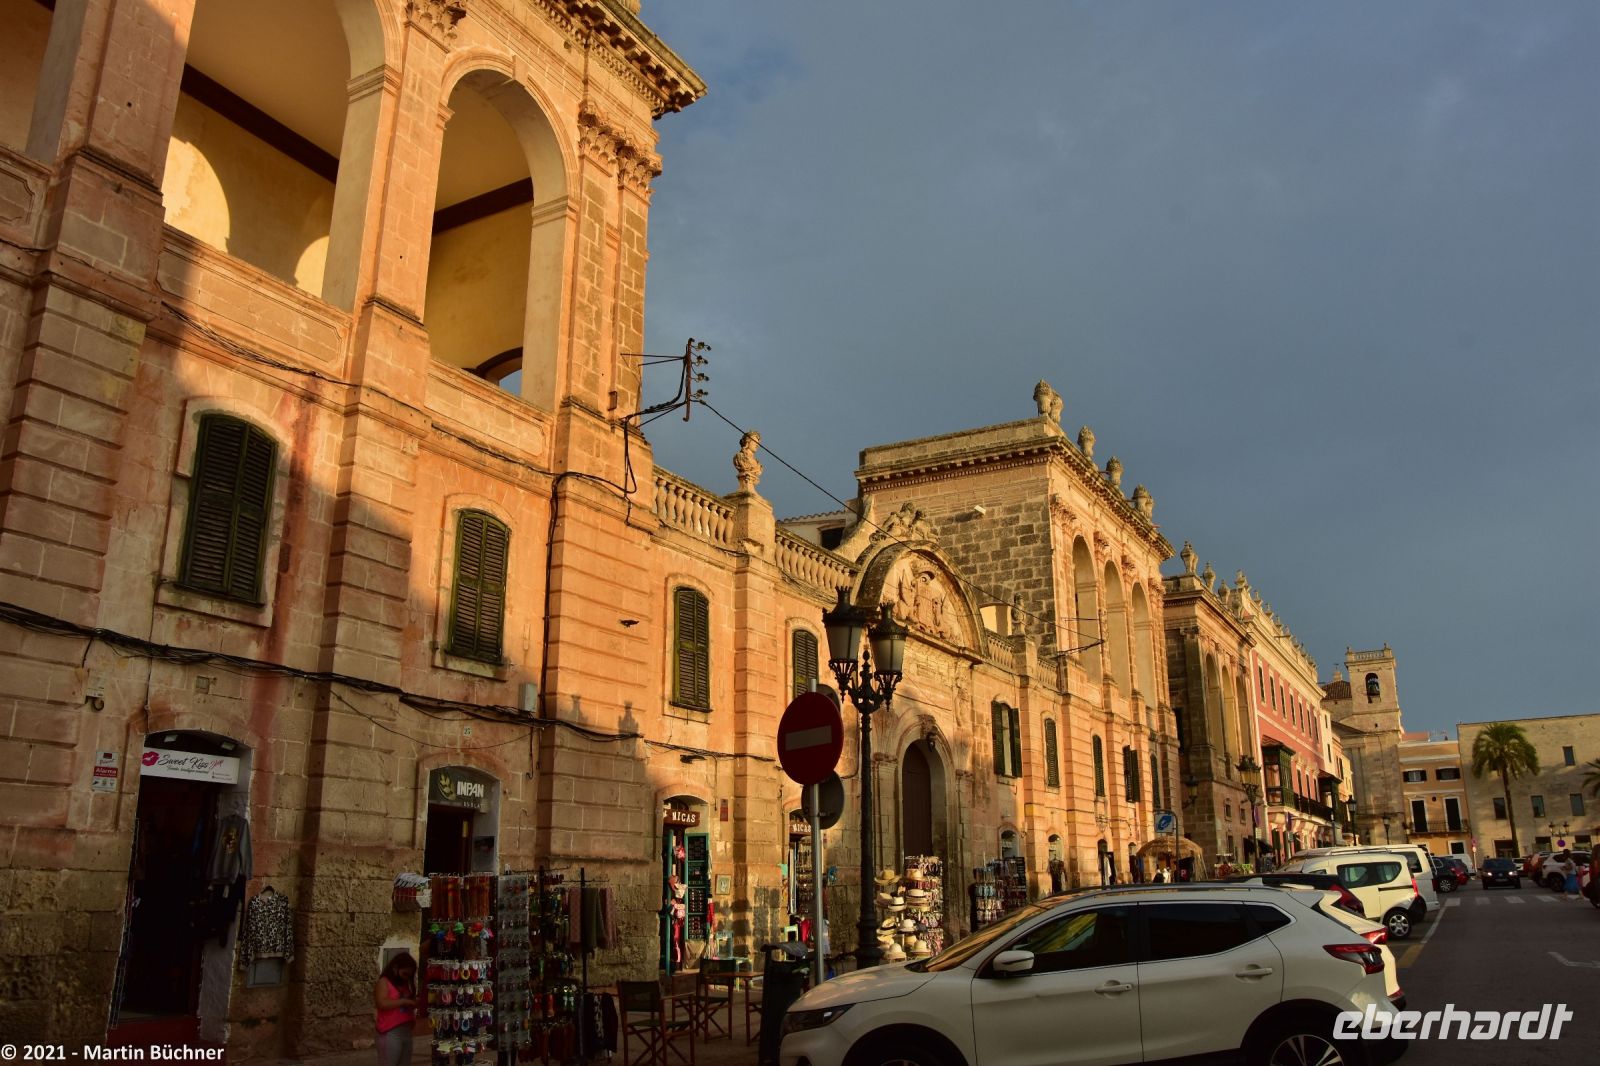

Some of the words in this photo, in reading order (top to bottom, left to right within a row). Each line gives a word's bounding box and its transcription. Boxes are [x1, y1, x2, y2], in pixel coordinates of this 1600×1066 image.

[157, 753, 188, 766] Sweet
[189, 757, 210, 769] Kiss
[456, 780, 485, 798] INPAN
